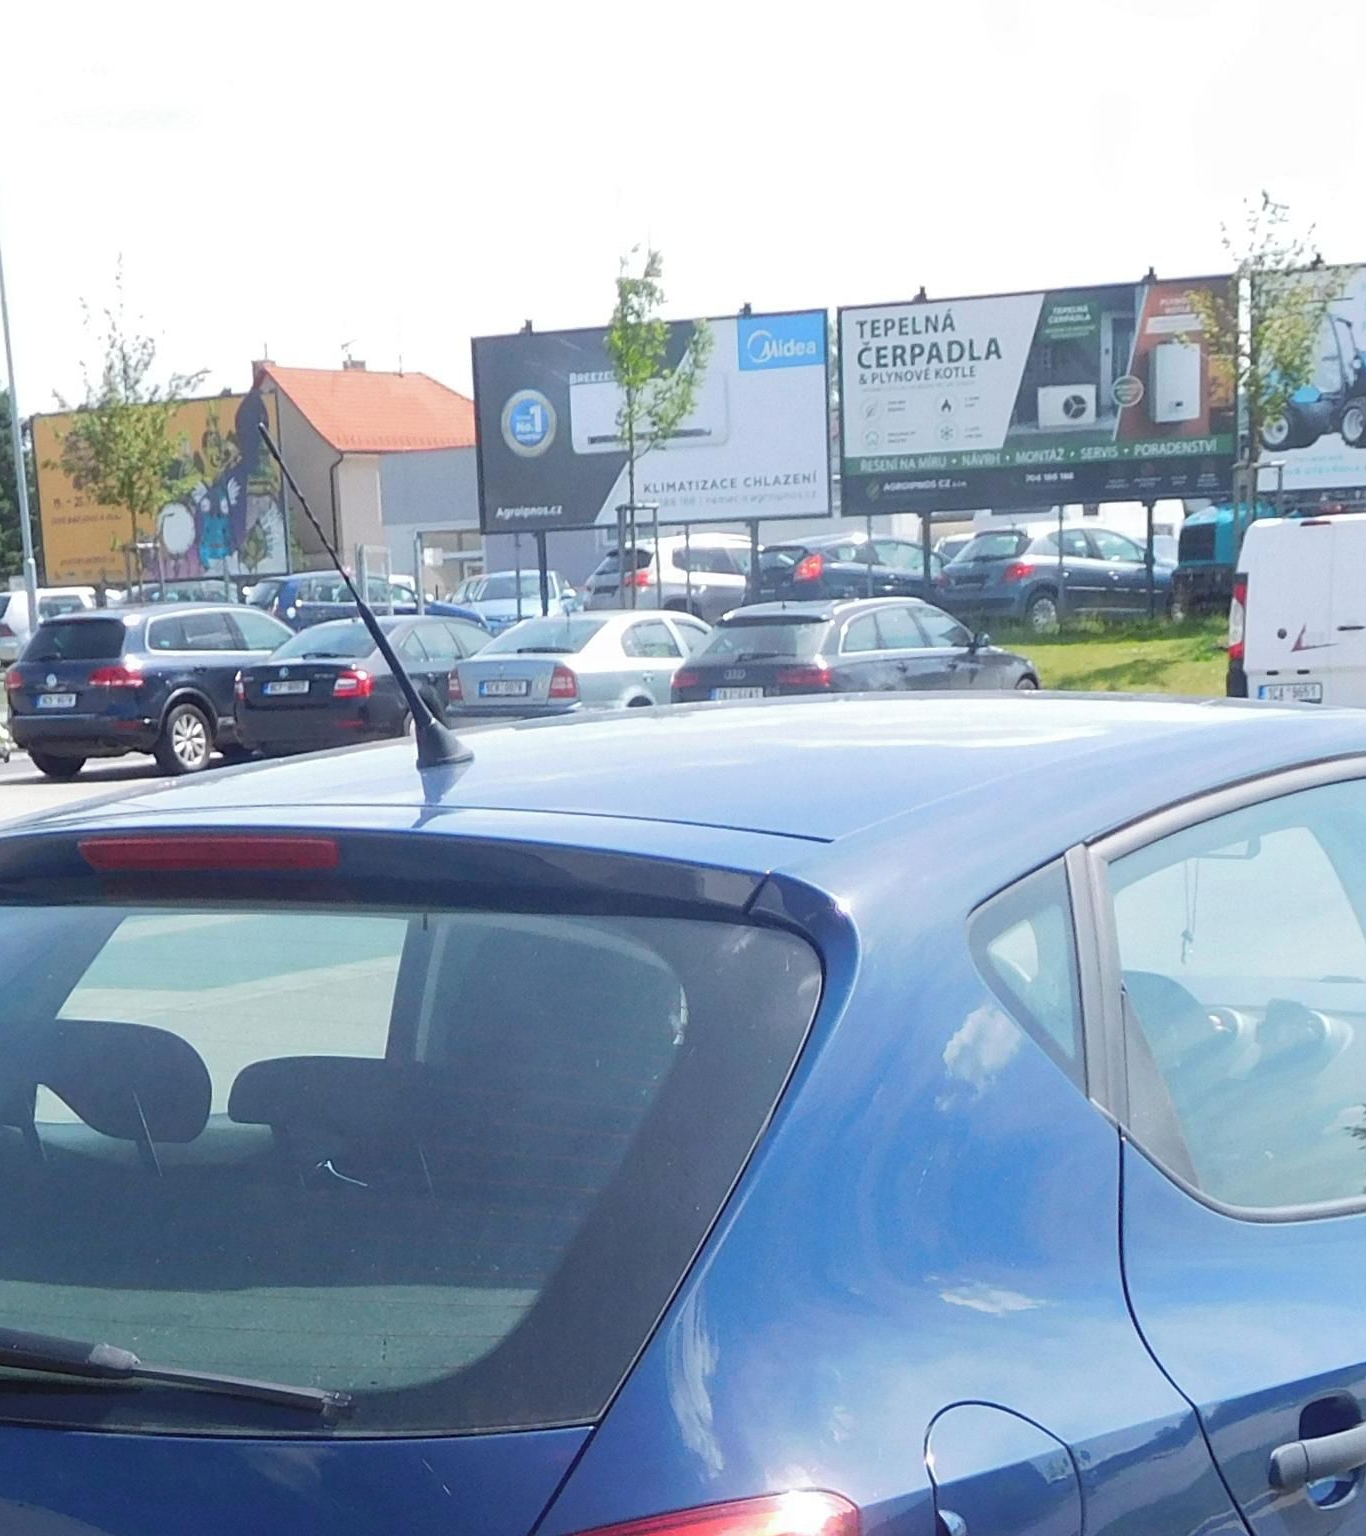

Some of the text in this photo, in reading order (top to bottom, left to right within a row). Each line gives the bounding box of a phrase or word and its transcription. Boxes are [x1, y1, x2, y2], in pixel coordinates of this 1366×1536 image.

[856, 308, 956, 339] TEPELNÁ
[857, 337, 1002, 369] ČERPADLA
[859, 365, 976, 385] & PLYNOVÉ KOTLE
[899, 458, 916, 470] NA
[1081, 445, 1118, 460] SERVIS
[1134, 438, 1217, 456] PORADENSTVÍ
[643, 470, 817, 494] KLIMATIZACE CHLAZENÍ
